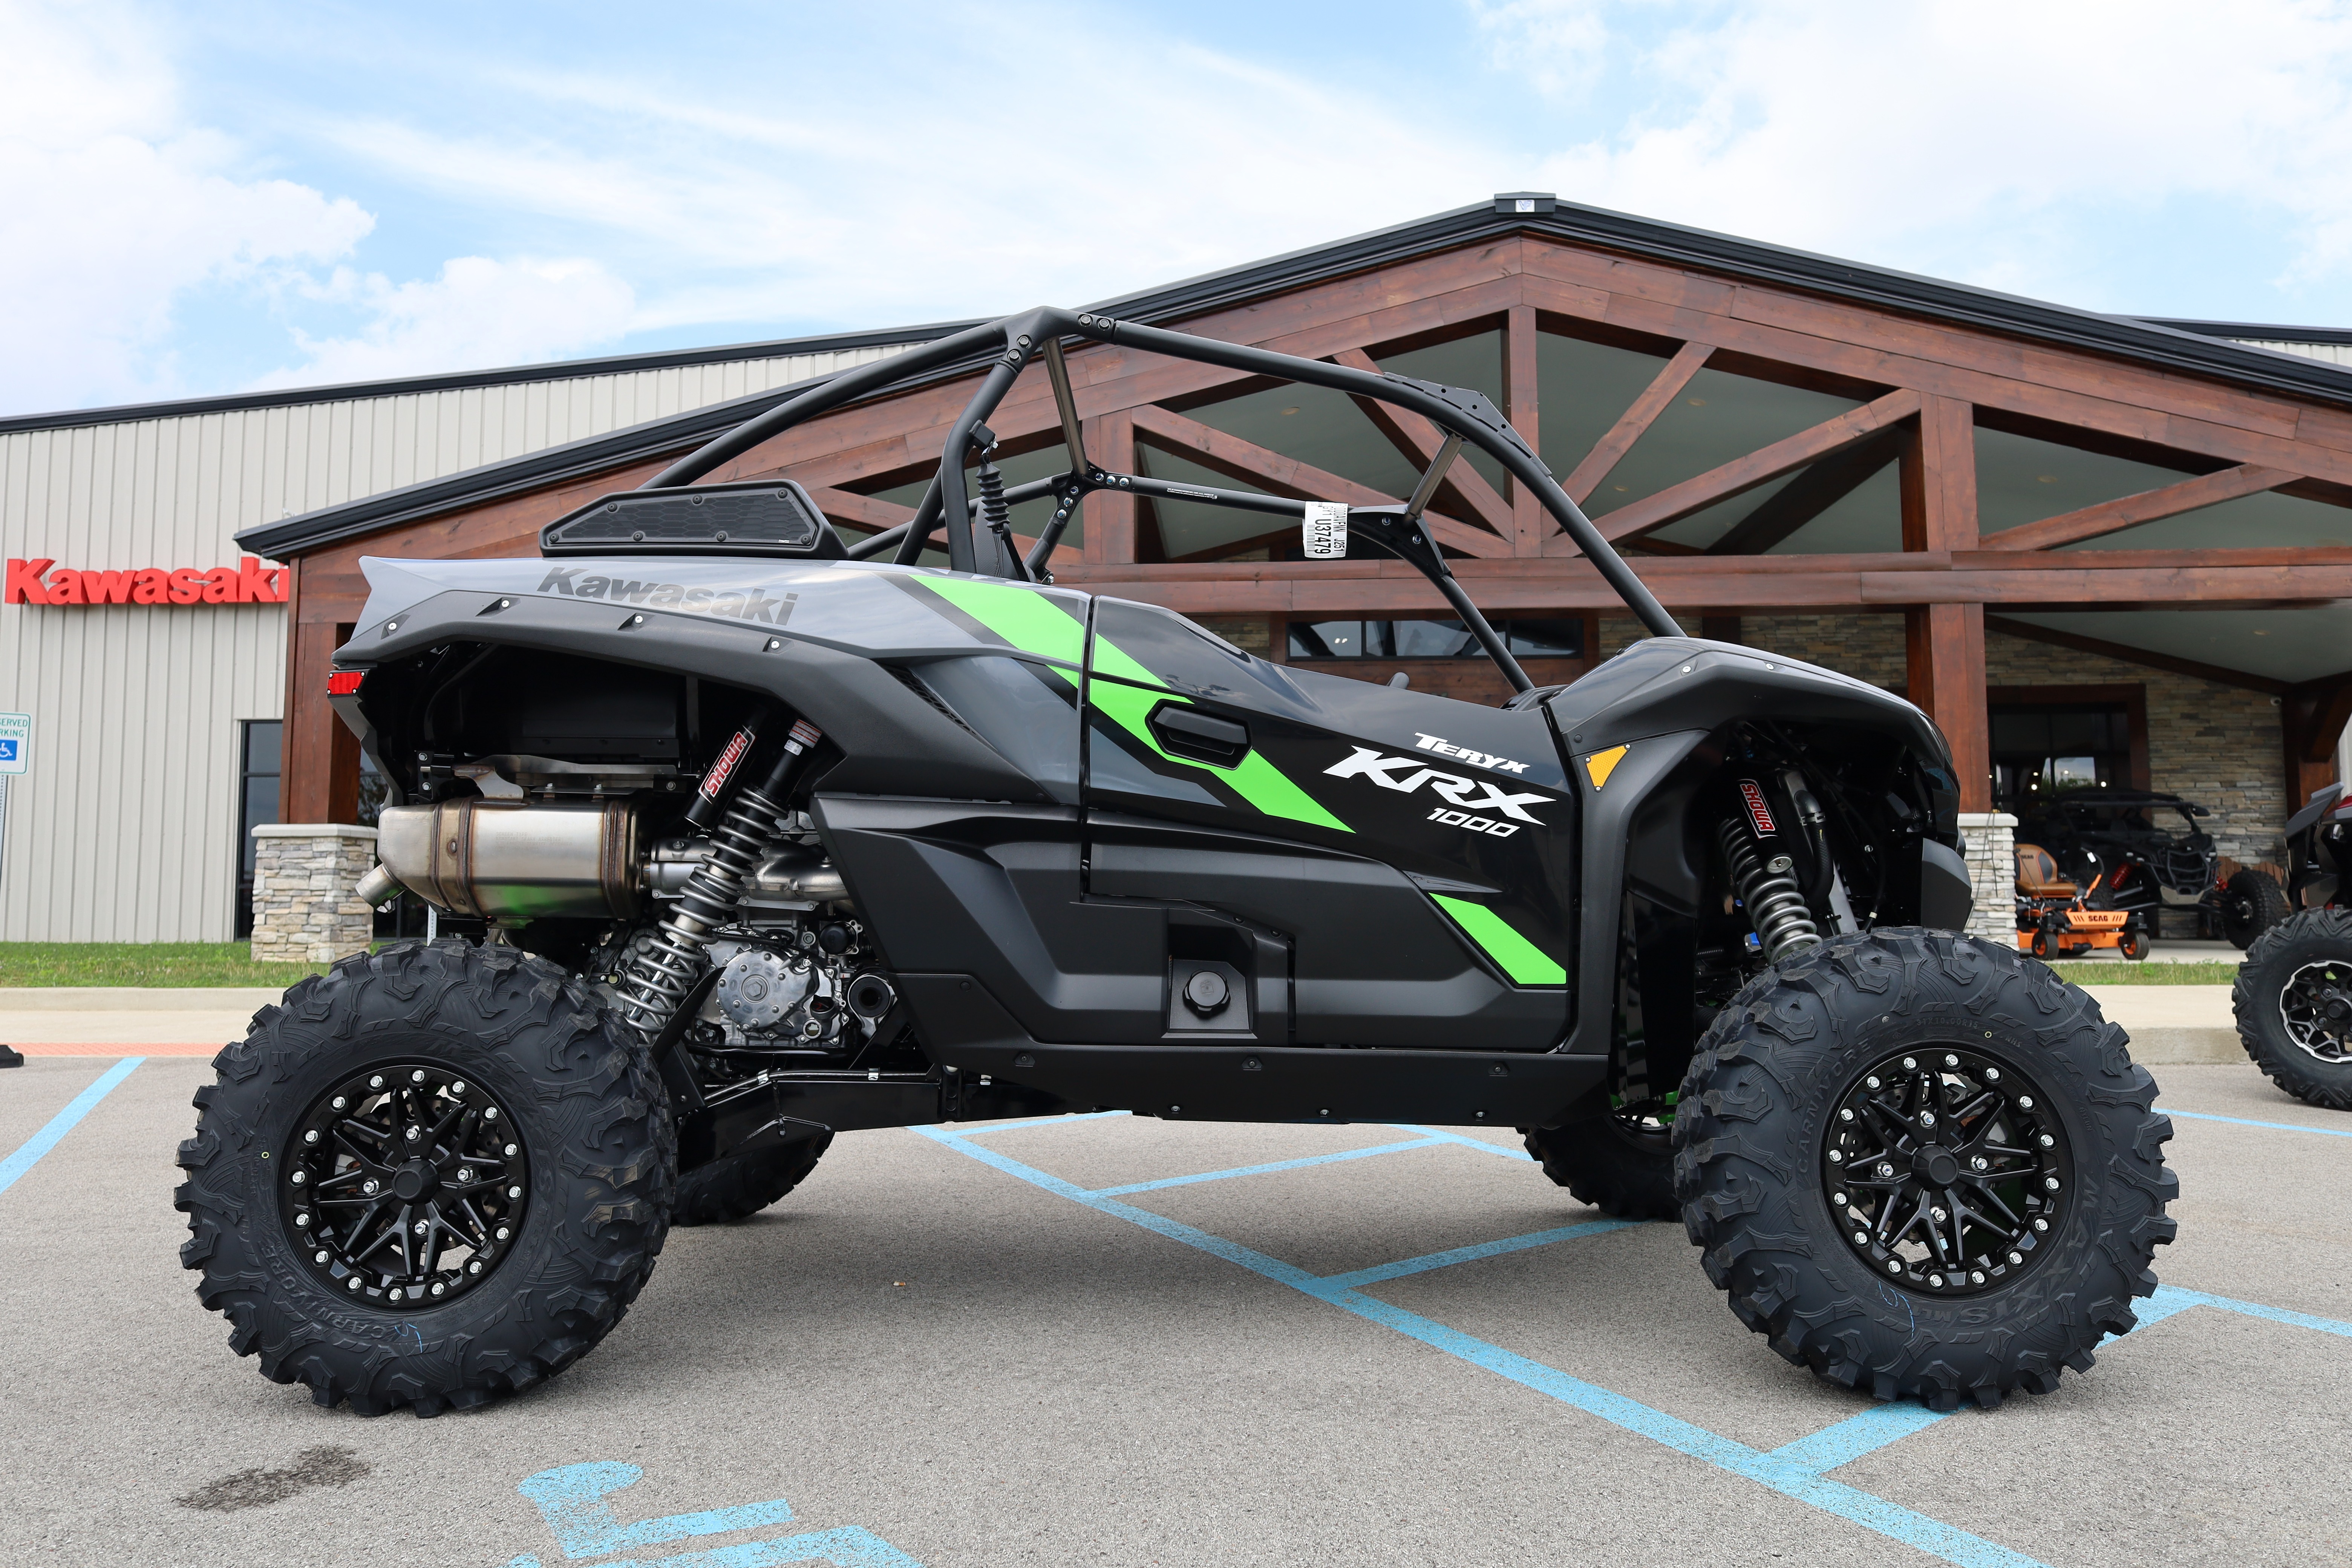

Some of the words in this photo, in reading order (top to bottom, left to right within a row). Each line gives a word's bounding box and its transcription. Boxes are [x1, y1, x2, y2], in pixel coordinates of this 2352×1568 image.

[1314, 519, 1331, 554] U37479
[1334, 538, 1345, 551] J251
[5, 557, 290, 604] Kawasaki
[537, 567, 799, 626] Kawasaki
[0, 718, 28, 727] ERVED
[704, 731, 748, 798] SHOWA
[1322, 745, 1557, 826] KRX
[1426, 807, 1521, 838] 1000
[1740, 784, 1775, 831] SHOWA
[1795, 1037, 1874, 1173] CARNIVORE
[1960, 1173, 2101, 1329] MAXXIS
[263, 1241, 386, 1345] CARNIVORE
